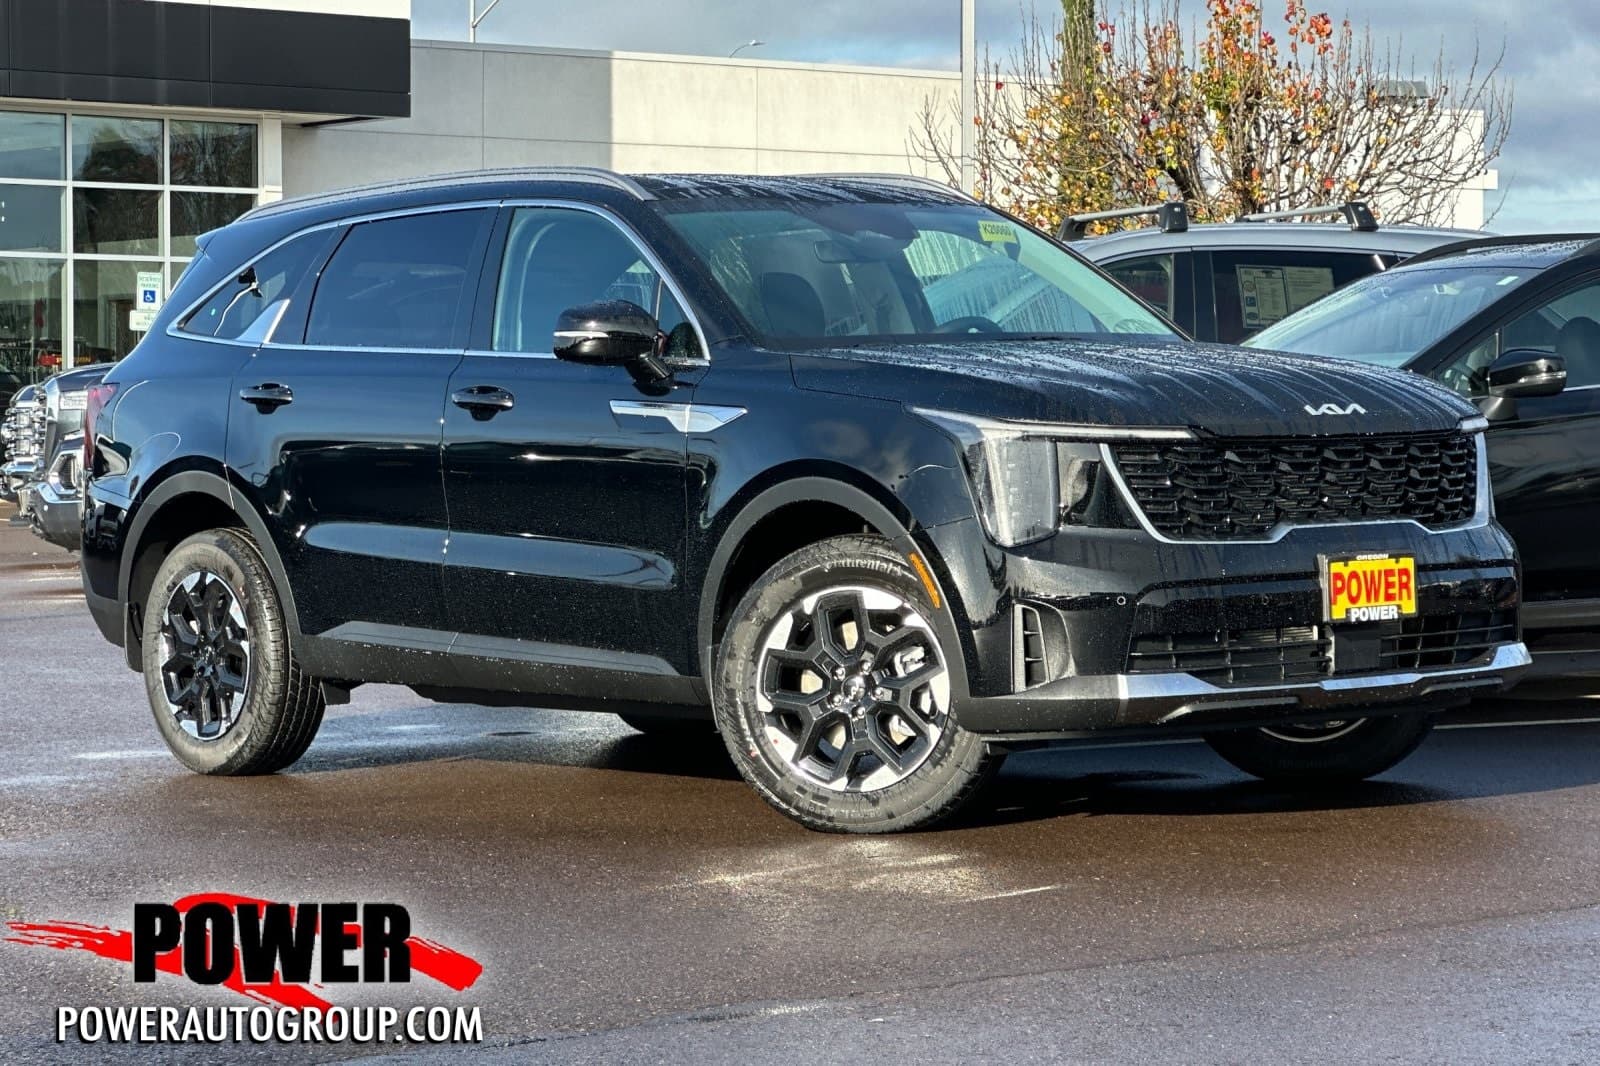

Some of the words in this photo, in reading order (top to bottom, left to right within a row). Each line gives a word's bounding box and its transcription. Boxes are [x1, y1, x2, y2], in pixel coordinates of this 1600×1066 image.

[1304, 403, 1367, 415] KIA
[1331, 568, 1412, 605] POWER
[1350, 605, 1399, 622] POWER
